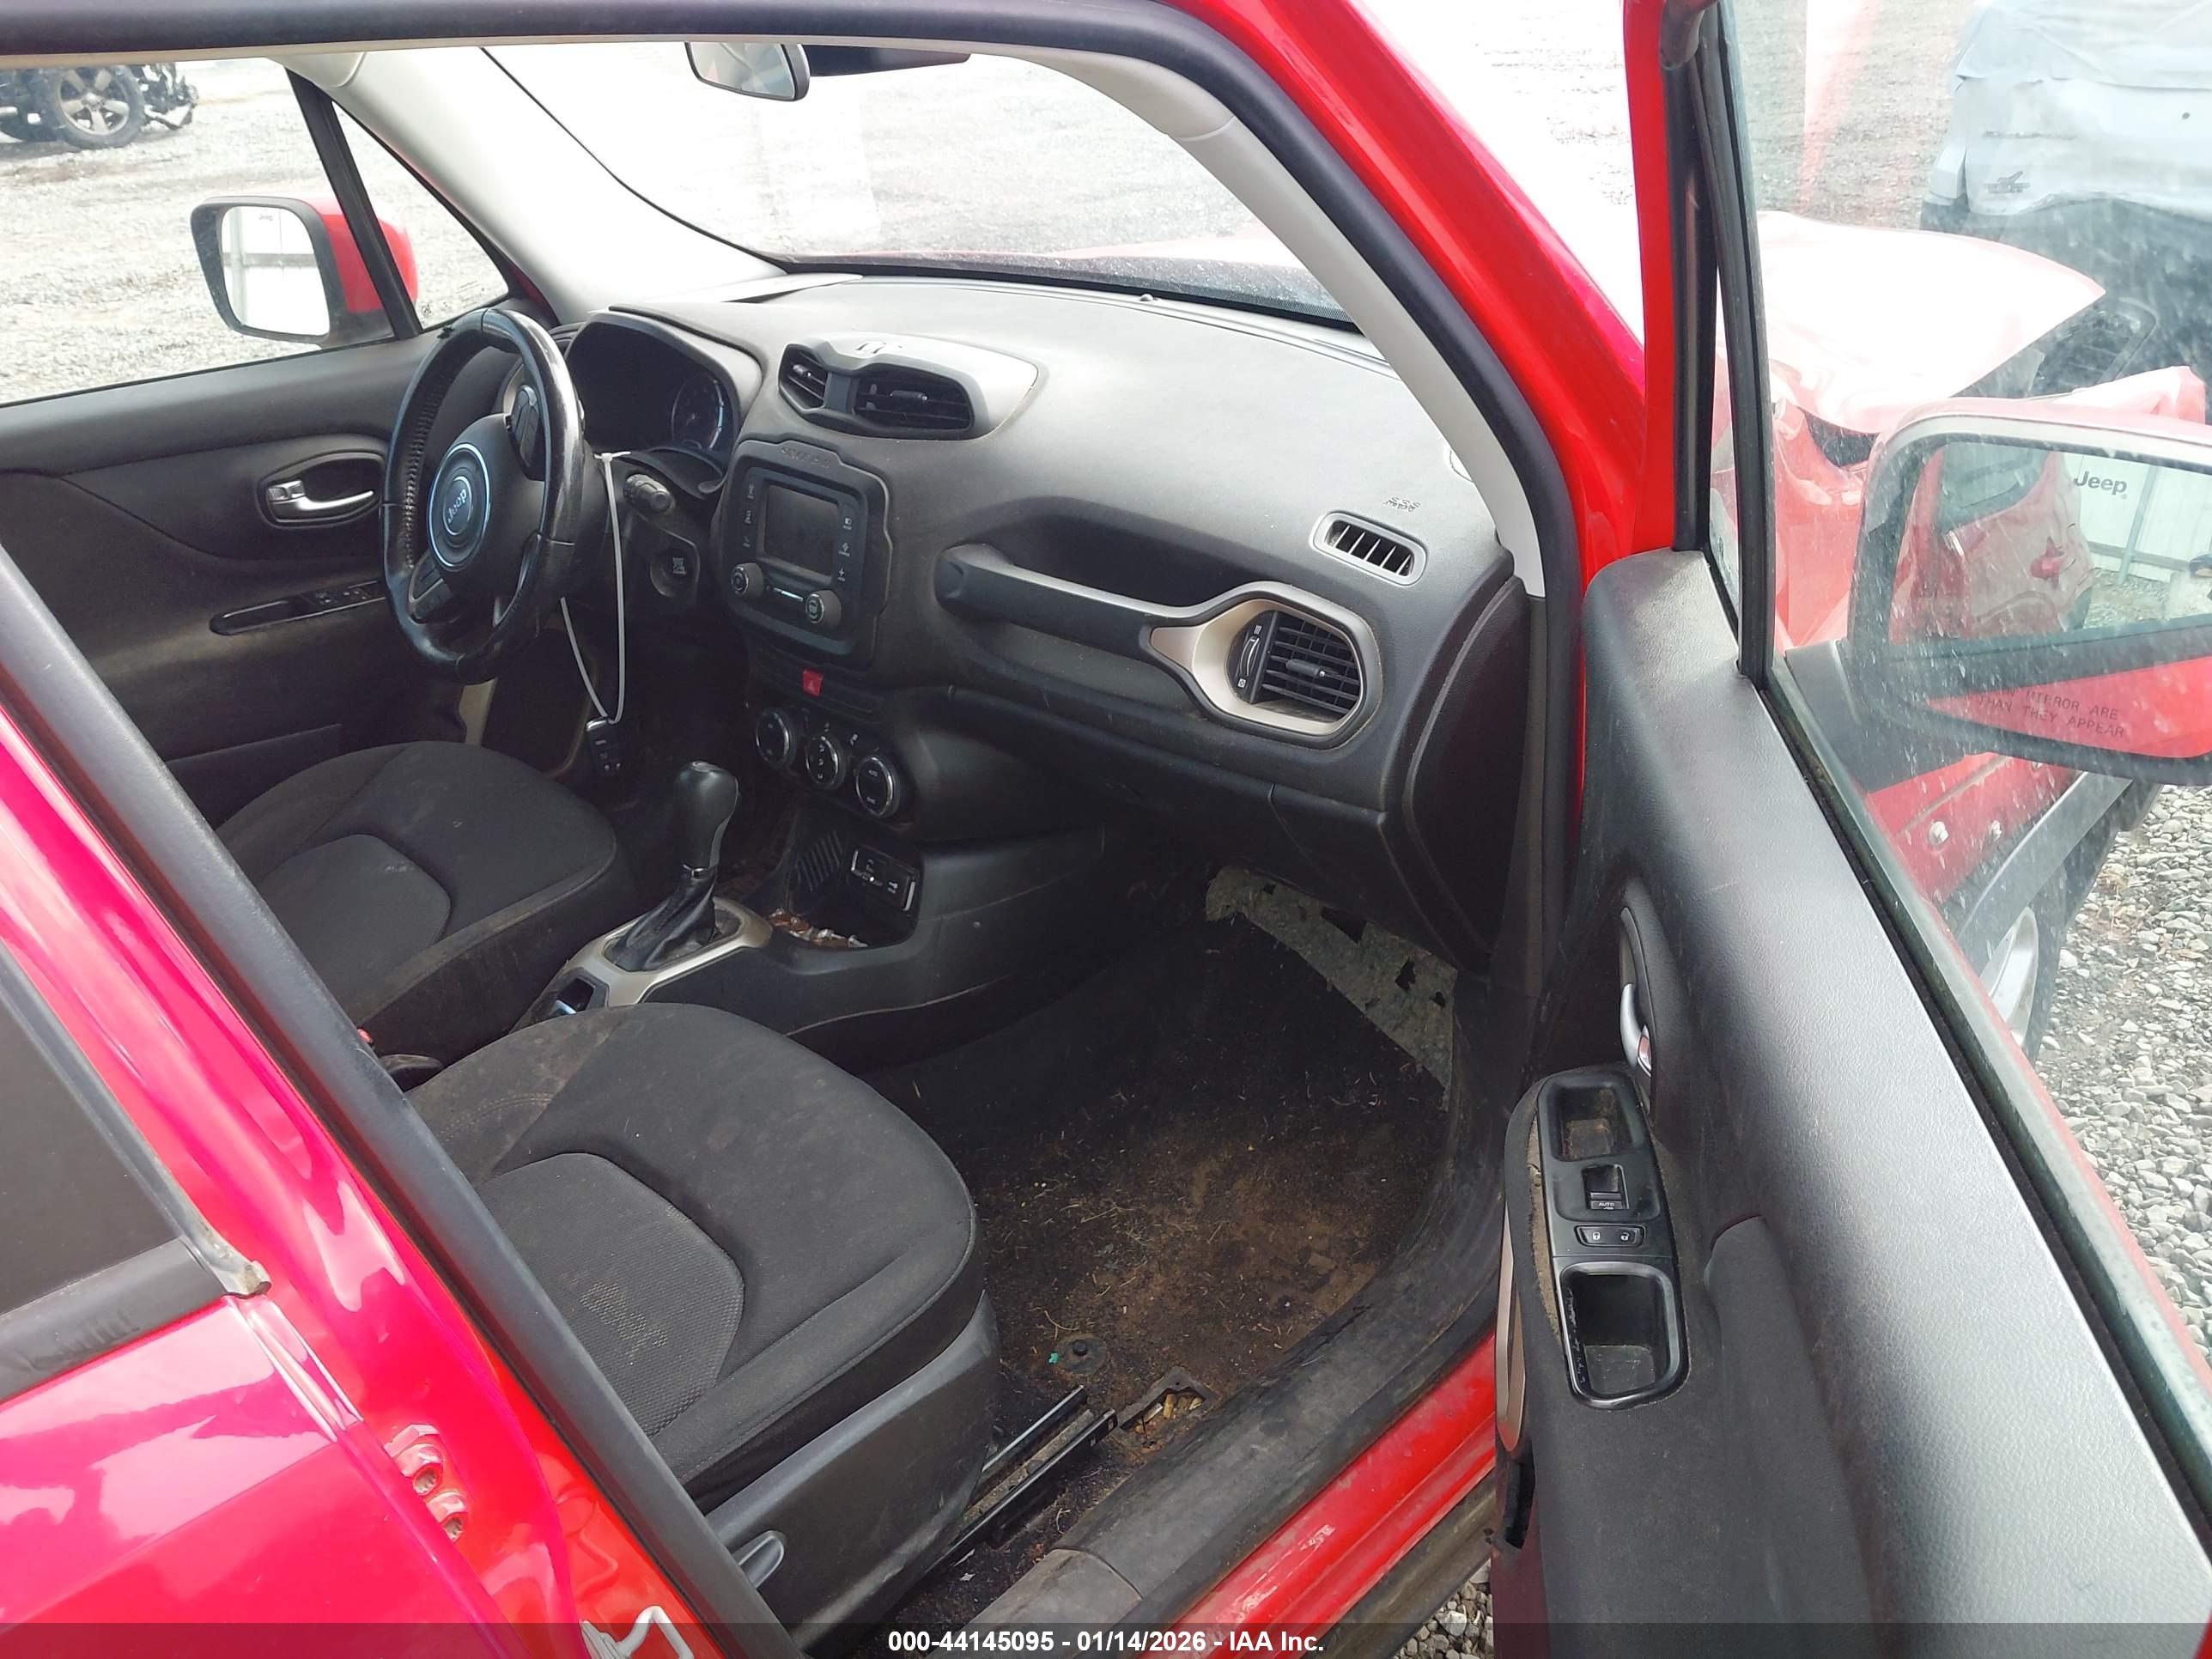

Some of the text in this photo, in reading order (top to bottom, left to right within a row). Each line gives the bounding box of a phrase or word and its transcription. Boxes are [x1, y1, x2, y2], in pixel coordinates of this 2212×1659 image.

[2073, 471, 2127, 495] Jeep
[447, 489, 467, 523] Jeep
[2022, 705, 2059, 723] THEY
[2065, 715, 2125, 738] APPEAR
[2089, 705, 2119, 720] ARE
